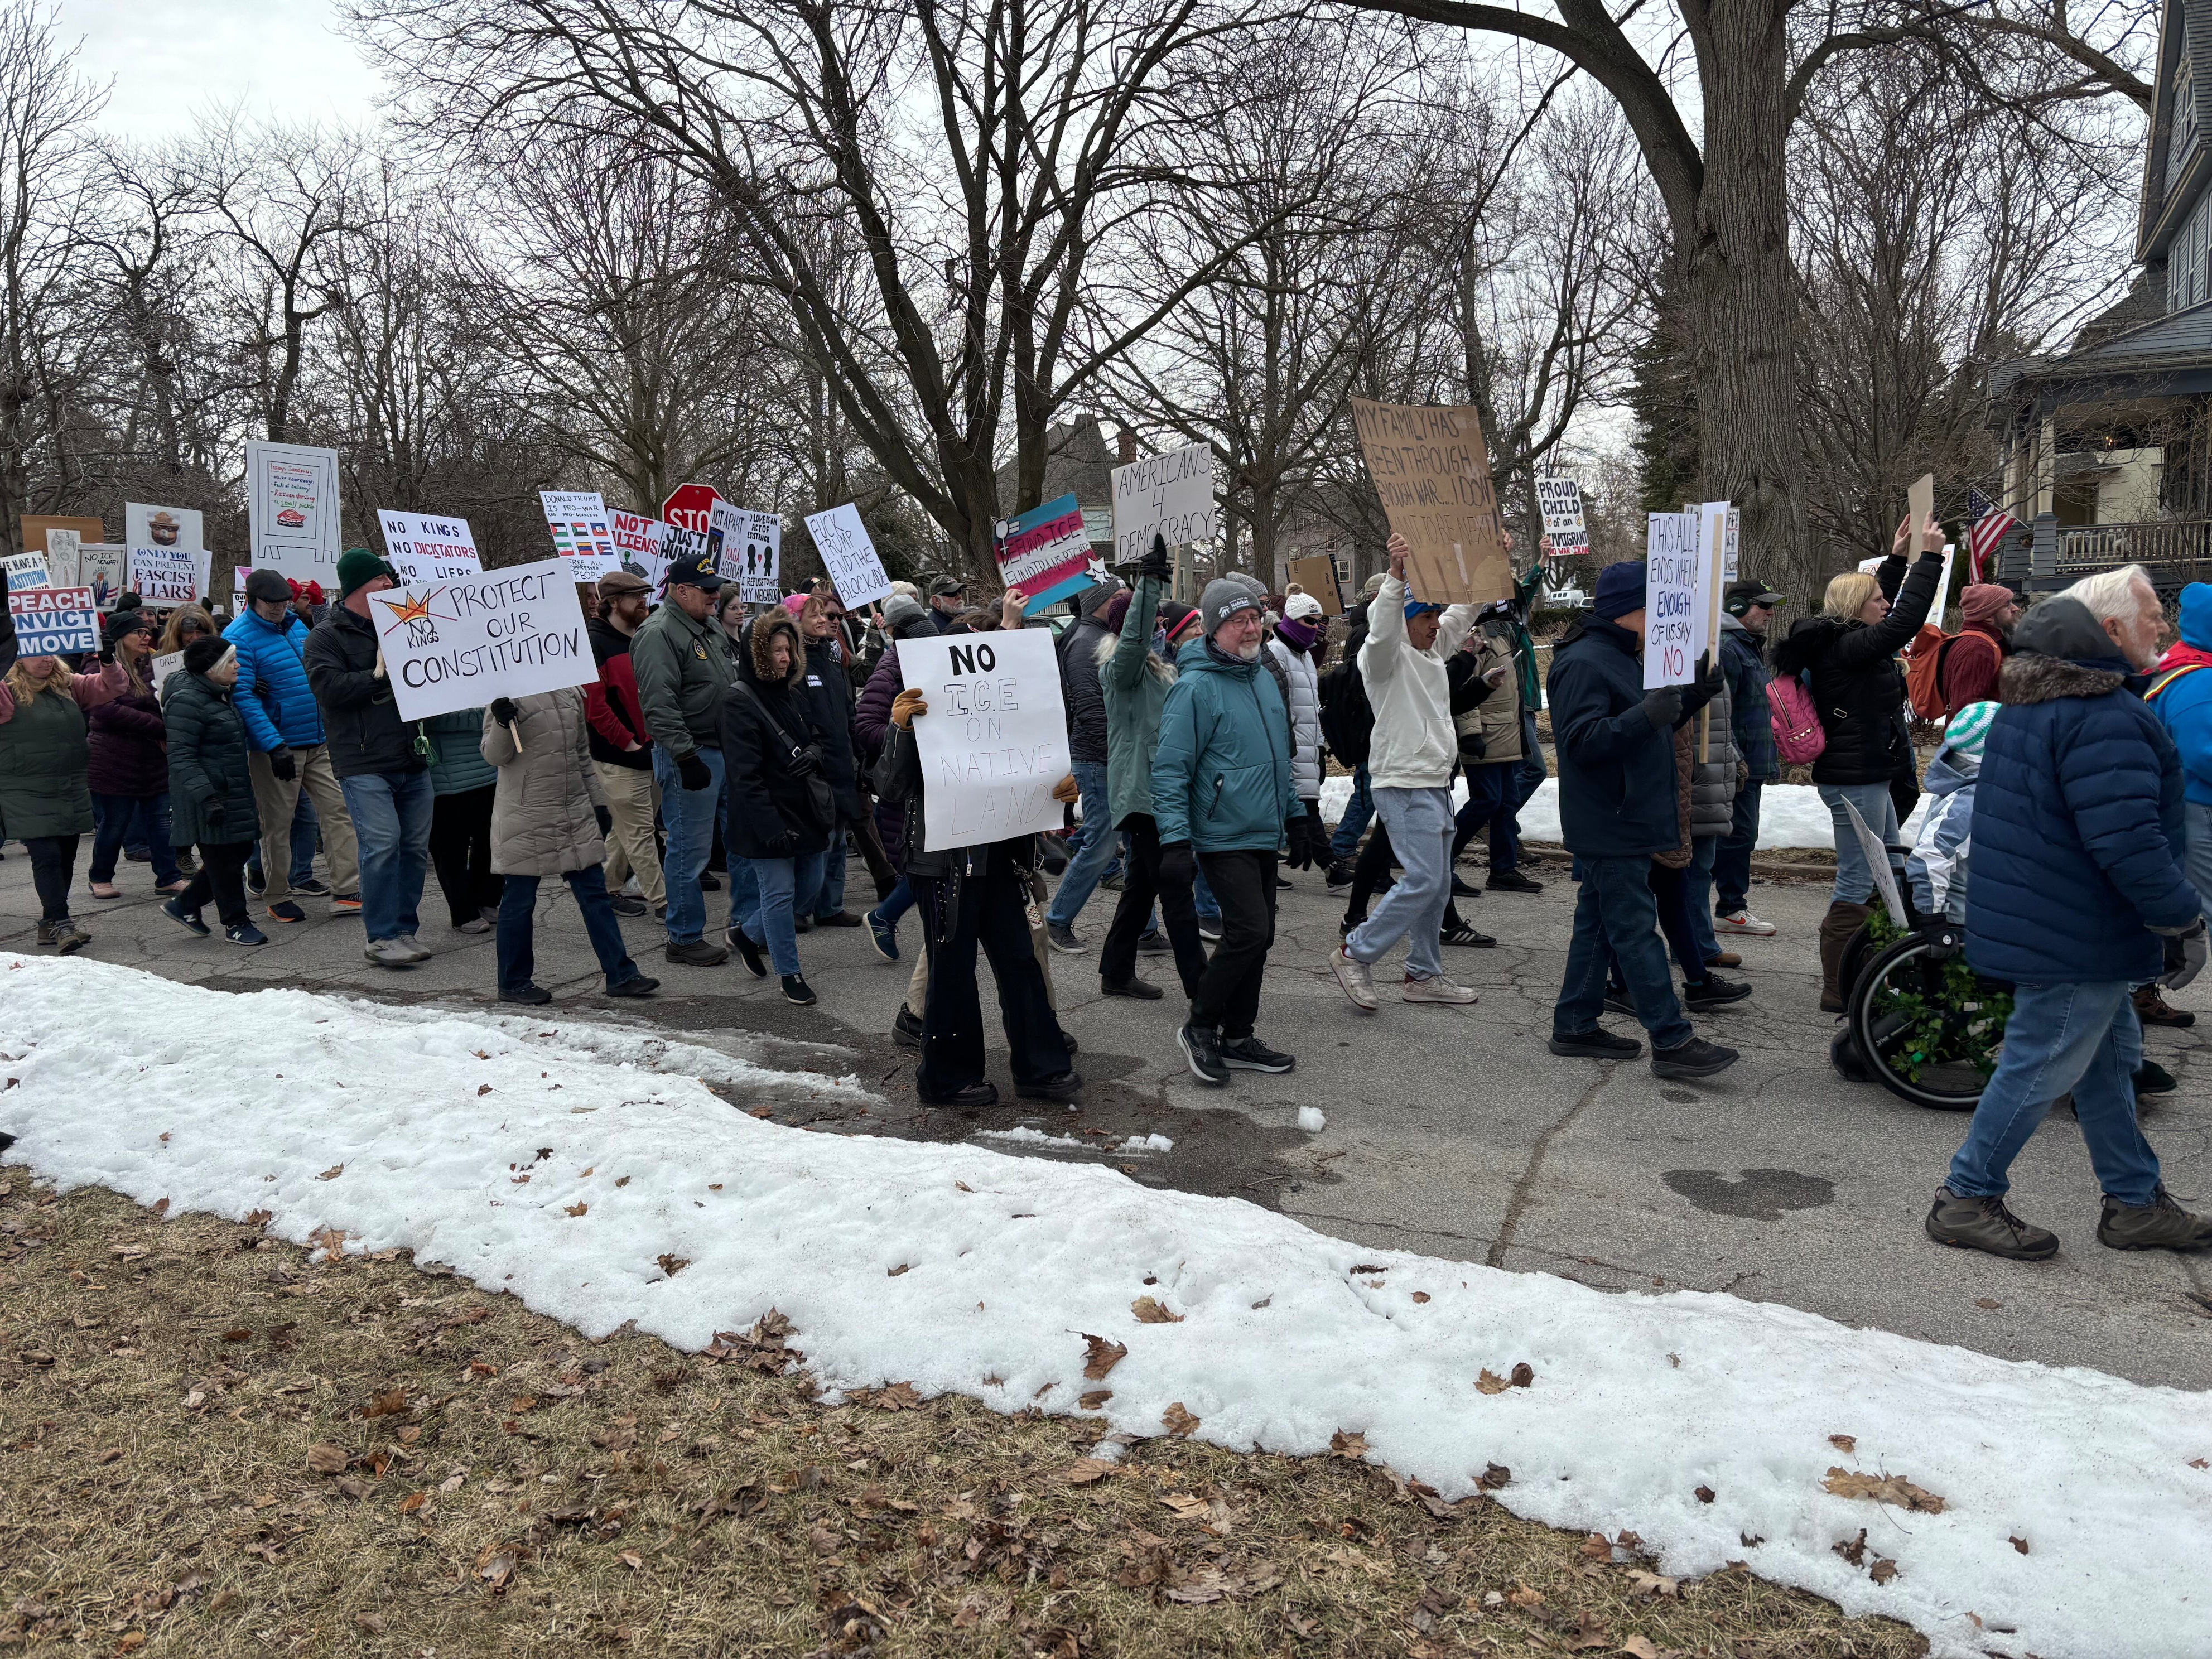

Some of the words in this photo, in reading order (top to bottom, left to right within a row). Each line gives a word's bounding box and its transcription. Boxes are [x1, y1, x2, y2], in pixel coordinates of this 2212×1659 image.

[1355, 404, 1379, 440] MY
[1379, 407, 1427, 441] FAMILY
[1427, 411, 1459, 438] HAS
[1362, 442, 1406, 475] BEEN
[1401, 444, 1472, 475] THROUGH
[1118, 447, 1210, 499] AMERICANS
[544, 495, 571, 503] DONALD
[1375, 479, 1414, 508] ENOUGH
[1538, 481, 1577, 498] PROUD
[1153, 487, 1165, 518] 4
[1543, 499, 1580, 515] CHILD
[387, 520, 406, 534] NO
[421, 522, 460, 537] KINGS
[615, 513, 654, 535] NOT
[669, 508, 710, 533] STO
[712, 507, 725, 527] NOT
[728, 513, 744, 534] PART
[751, 523, 763, 532] ACT
[762, 525, 769, 534] OF
[754, 513, 766, 524] LOVE
[810, 513, 844, 543] FUCK
[1420, 515, 1438, 544] TO
[1435, 513, 1457, 545] BE
[1457, 507, 1501, 547] NEXT!
[1553, 517, 1560, 527] of
[1563, 518, 1573, 527] an
[666, 525, 707, 549] JUST
[747, 531, 770, 543] ESISTANCE
[1045, 515, 1081, 548] ICE
[1119, 508, 1213, 563] DEMOCRACY
[1650, 515, 1674, 553] THIS
[1676, 515, 1693, 554] ALL
[137, 548, 168, 558] ONLY
[168, 551, 192, 561] YOU
[392, 541, 411, 554] NO
[413, 542, 476, 558] DICKTATORS
[659, 541, 706, 560] HUM
[725, 544, 740, 563] MAGA
[818, 530, 854, 559] TRUMP
[1572, 546, 1590, 554] IRAN
[12, 558, 31, 570] HAVE
[32, 557, 38, 568] A
[85, 554, 98, 563] NO
[133, 558, 153, 567] CAN
[155, 561, 196, 571] PREVENT
[830, 554, 853, 581] END
[851, 546, 874, 569] THE
[1005, 565, 1037, 587] FUND
[1031, 554, 1066, 580] TRANS
[1062, 543, 1094, 567] RIGHTS
[7, 569, 48, 591] NSTITUTION
[135, 568, 196, 583] FASCIST
[574, 571, 606, 580] PEOPL
[748, 577, 764, 586] REFUSE
[837, 566, 890, 602] BLOCKADE
[1651, 556, 1673, 585] ENDS
[1675, 558, 1695, 589] WHEN
[9, 591, 91, 613] PEACH
[137, 582, 194, 599] LIARS
[450, 571, 555, 617] PROTECT
[741, 587, 753, 602] MY
[1657, 590, 1690, 618] ENOUGH
[11, 609, 94, 630] NVICT
[409, 620, 435, 636] NO
[486, 613, 536, 638] OUR
[17, 631, 94, 655] MOVE
[407, 631, 440, 649] KINGS
[1651, 623, 1665, 645] OF
[1665, 623, 1675, 642] US
[1674, 621, 1693, 646] SAY
[160, 655, 177, 667] ONLY
[402, 628, 578, 688] CONSTITUTION
[948, 644, 996, 676] NO
[1662, 645, 1684, 679] NO
[966, 717, 1001, 742] ON
[941, 744, 1055, 787] NATIVE
[951, 783, 1049, 836] LAND
